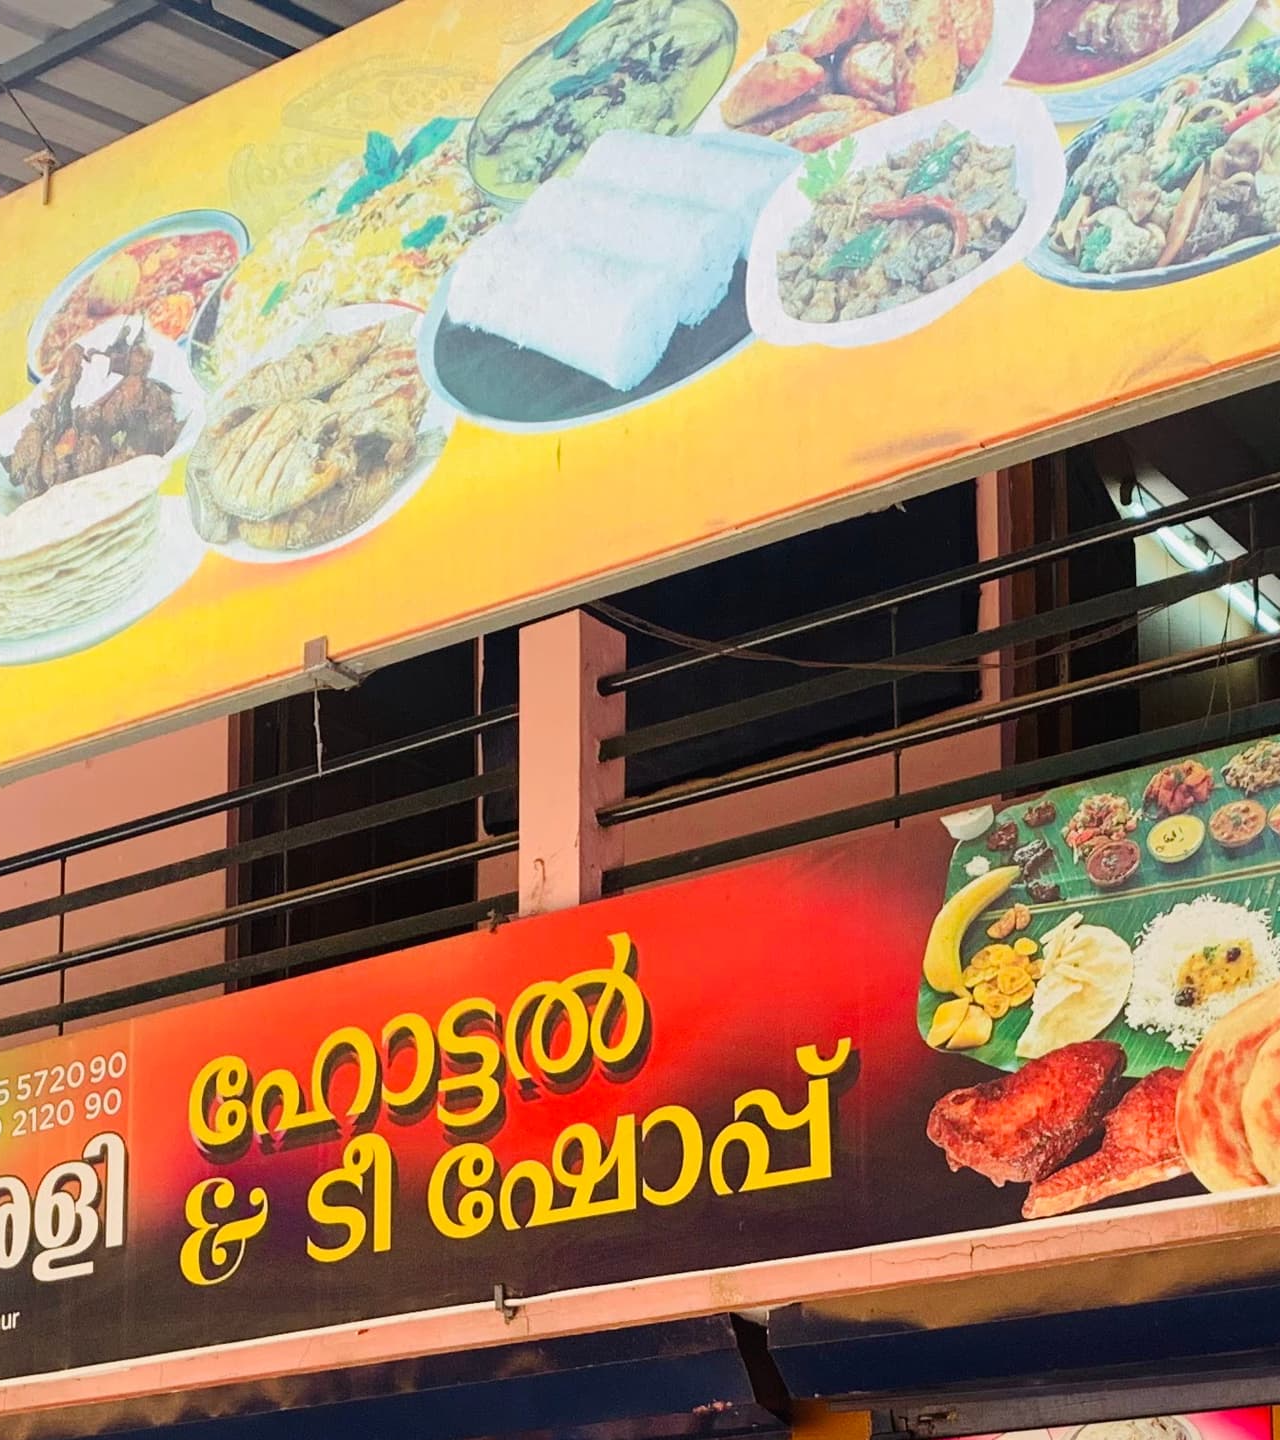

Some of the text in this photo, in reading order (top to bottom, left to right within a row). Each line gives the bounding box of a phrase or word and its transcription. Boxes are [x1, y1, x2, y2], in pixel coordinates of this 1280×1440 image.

[12, 1099, 74, 1137] 2120
[84, 1088, 122, 1120] 90
[189, 932, 645, 1144] ഹോട്ടൽ
[178, 1036, 853, 1285] & ടീ ഷോപ്പ്
